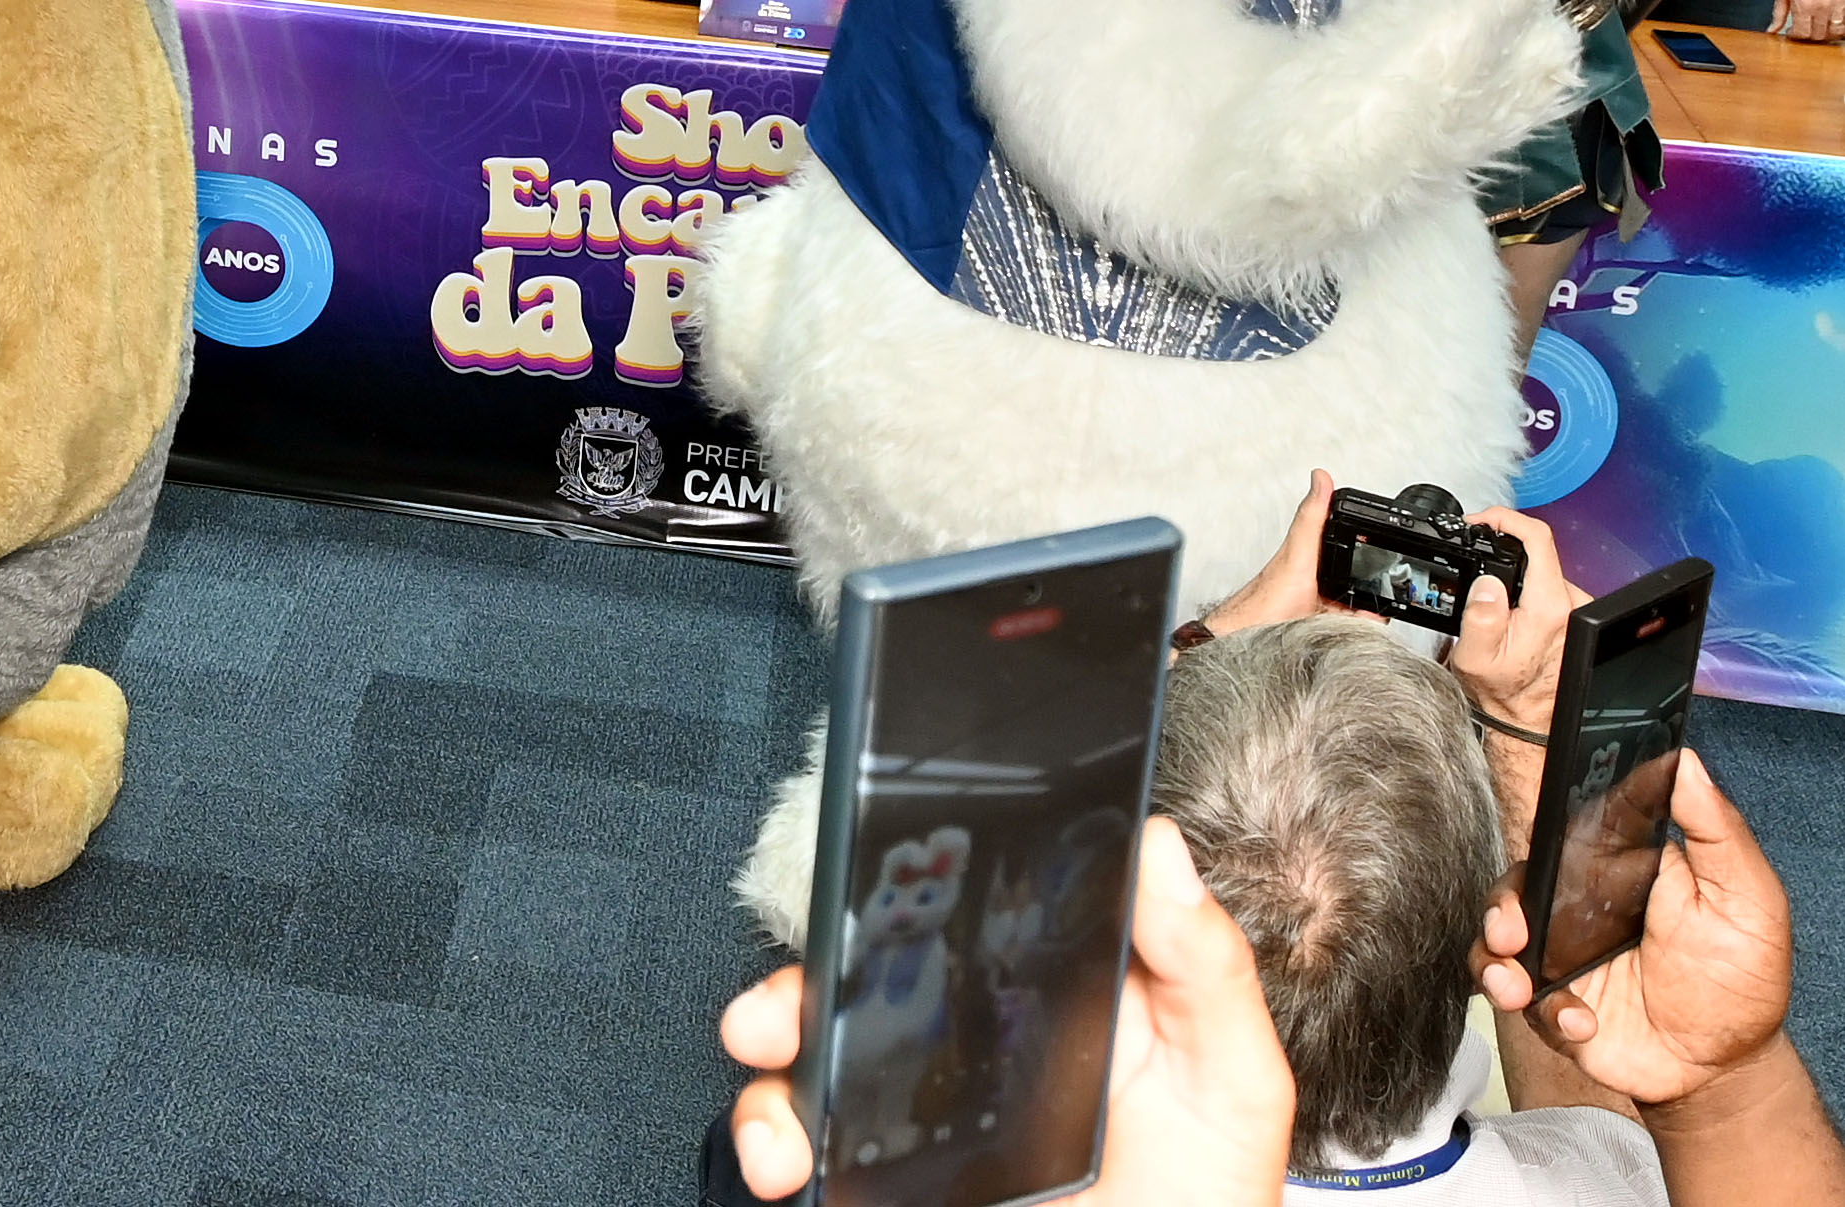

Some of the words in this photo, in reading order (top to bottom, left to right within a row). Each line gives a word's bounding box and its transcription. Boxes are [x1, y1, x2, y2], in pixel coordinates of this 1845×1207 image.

[612, 83, 807, 191] Sho
[204, 247, 280, 274] ANOS
[431, 246, 594, 381] da
[1367, 1164, 1426, 1184] Câmara
